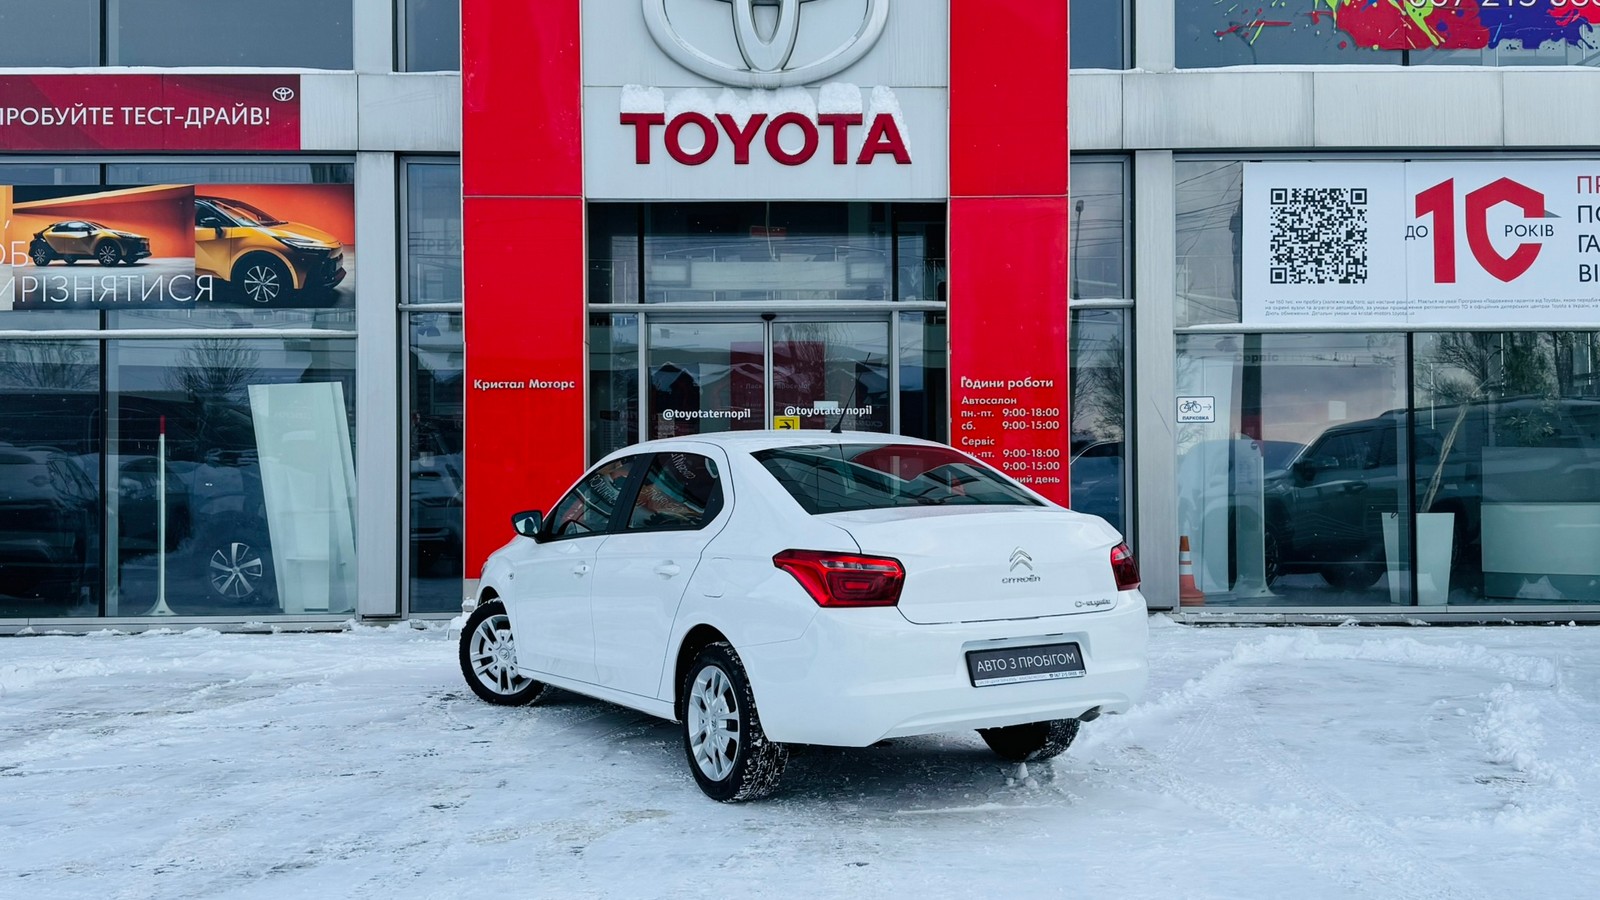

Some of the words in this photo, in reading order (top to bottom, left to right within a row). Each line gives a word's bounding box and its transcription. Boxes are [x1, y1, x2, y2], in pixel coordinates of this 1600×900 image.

[0, 103, 114, 125] РОБУЙТЕ
[121, 103, 271, 129] ТЕСТ-ДРАЙВ!
[620, 111, 912, 165] TOYOTA
[1578, 205, 1600, 223] П
[1405, 225, 1428, 241] ДО
[1504, 224, 1555, 237] РОКІВ
[473, 379, 525, 391] Кристал
[529, 378, 576, 391] Моторс
[960, 376, 1005, 390] Години
[1008, 377, 1054, 390] роботи
[961, 396, 1017, 405] Автосалон
[662, 408, 752, 421] @toyotaternopil
[784, 405, 873, 418] @toyotaternopil
[961, 410, 995, 418] пн.-пт.
[1002, 408, 1060, 417] 9:00-18:00
[961, 421, 977, 431] сб.
[1002, 421, 1060, 430] 9:00-15:00
[961, 436, 996, 448] Сервіс
[1002, 449, 1060, 458] 9:00-18:00
[1002, 461, 1060, 470] 9:00-15:00
[977, 658, 1007, 673] АВТО
[1018, 652, 1077, 669] ПРОБІГОМ
